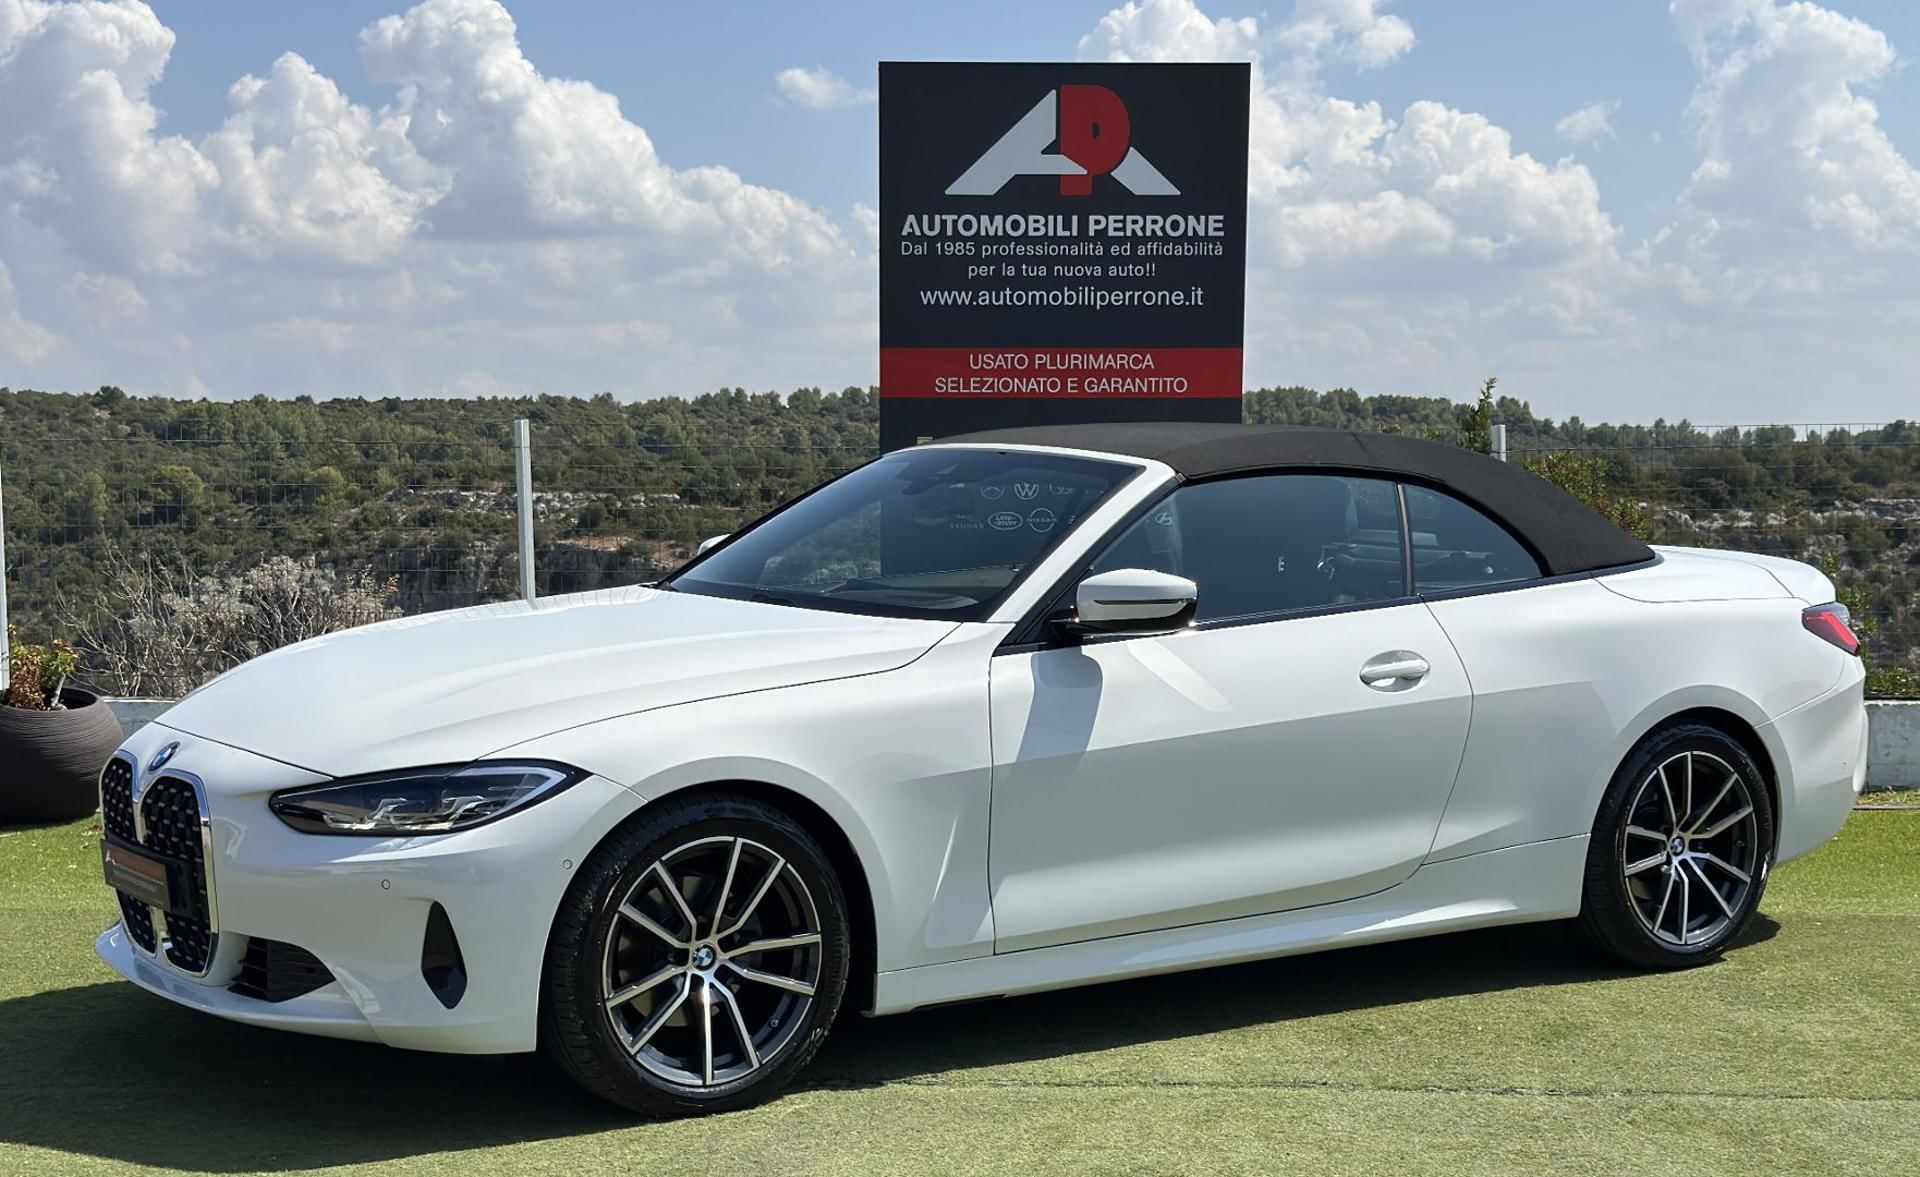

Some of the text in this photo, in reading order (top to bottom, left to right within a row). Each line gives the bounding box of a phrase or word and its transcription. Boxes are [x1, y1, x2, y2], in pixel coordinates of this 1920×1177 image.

[901, 214, 1225, 237] AUTOMOBILI PERRONE
[901, 241, 1223, 259] Dal 1985 professionalità ed affidabilità
[968, 262, 1156, 279] per la tua nuova auto!!
[920, 286, 1204, 310] www.automobiliperrone.it
[969, 353, 1155, 370] USATO PLURIMARCA
[934, 376, 1188, 393] SELEZIONATO E GARANTITO
